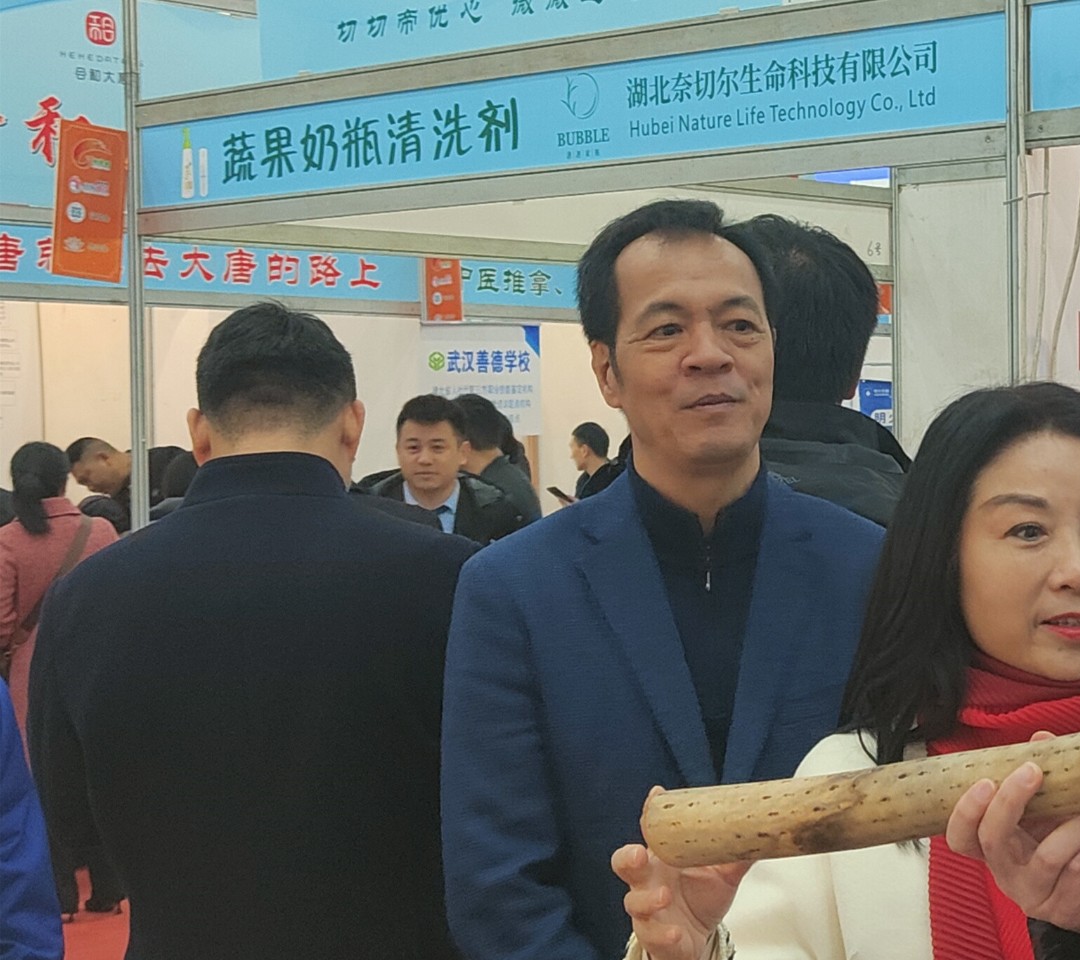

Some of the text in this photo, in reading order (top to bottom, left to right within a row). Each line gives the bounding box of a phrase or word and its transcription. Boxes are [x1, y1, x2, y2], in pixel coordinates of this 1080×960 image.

[627, 40, 938, 109] 湖北奈切尔生命科技有限公司
[557, 128, 610, 147] BUBBLE
[629, 86, 936, 138] Hubei Nature Life Technology Co., Ltd
[222, 97, 520, 185] 蔬果奶瓶清洗剂
[446, 350, 531, 373] 武汉善德学校
